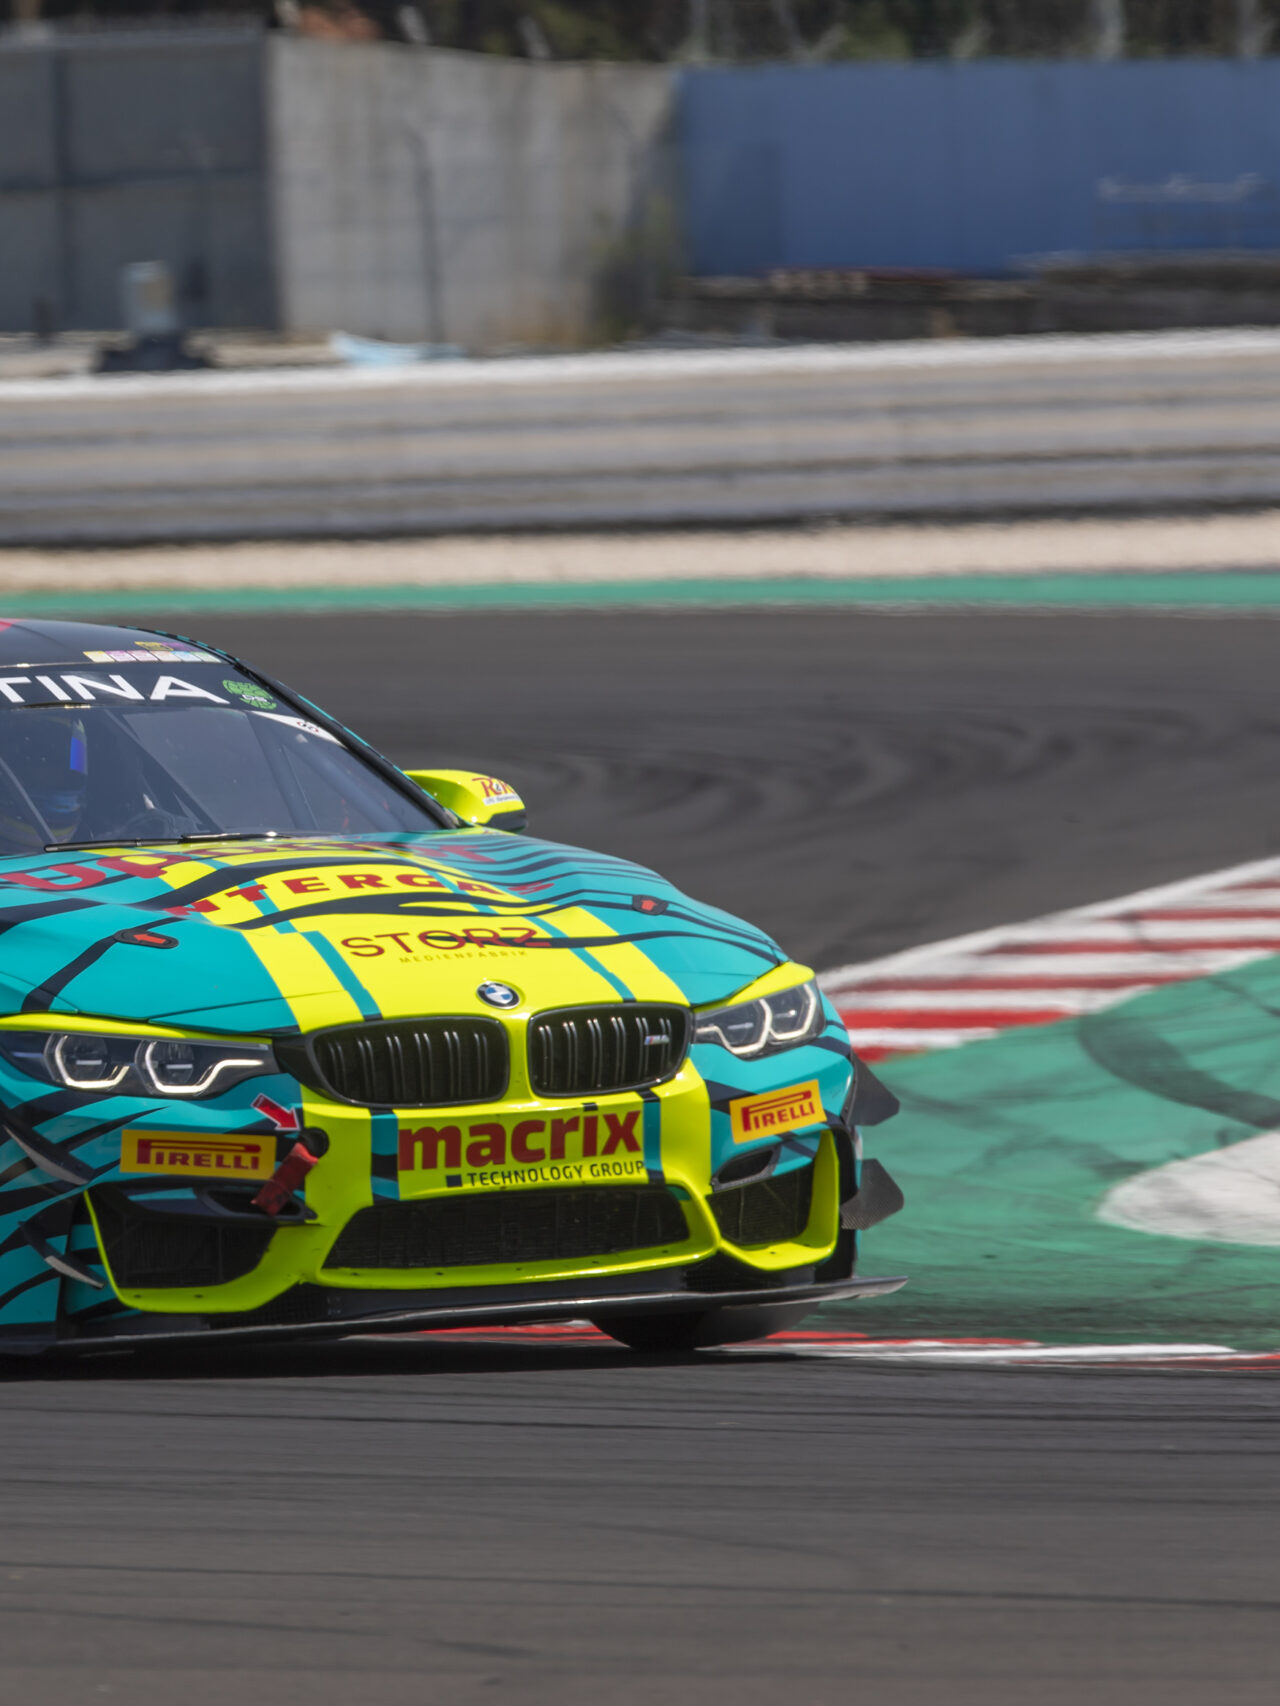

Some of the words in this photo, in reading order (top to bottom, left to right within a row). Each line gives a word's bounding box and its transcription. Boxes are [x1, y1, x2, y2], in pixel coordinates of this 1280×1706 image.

[162, 873, 556, 916] NTERGAS
[341, 927, 552, 957] STORZ
[399, 949, 528, 964] MEDIENFABRIK
[741, 1090, 815, 1132] PIRELLI
[398, 1102, 642, 1172] macrix
[136, 1138, 261, 1170] PIRELLI
[466, 1164, 583, 1187] TECHNOLOGY
[590, 1160, 645, 1178] GROUP
